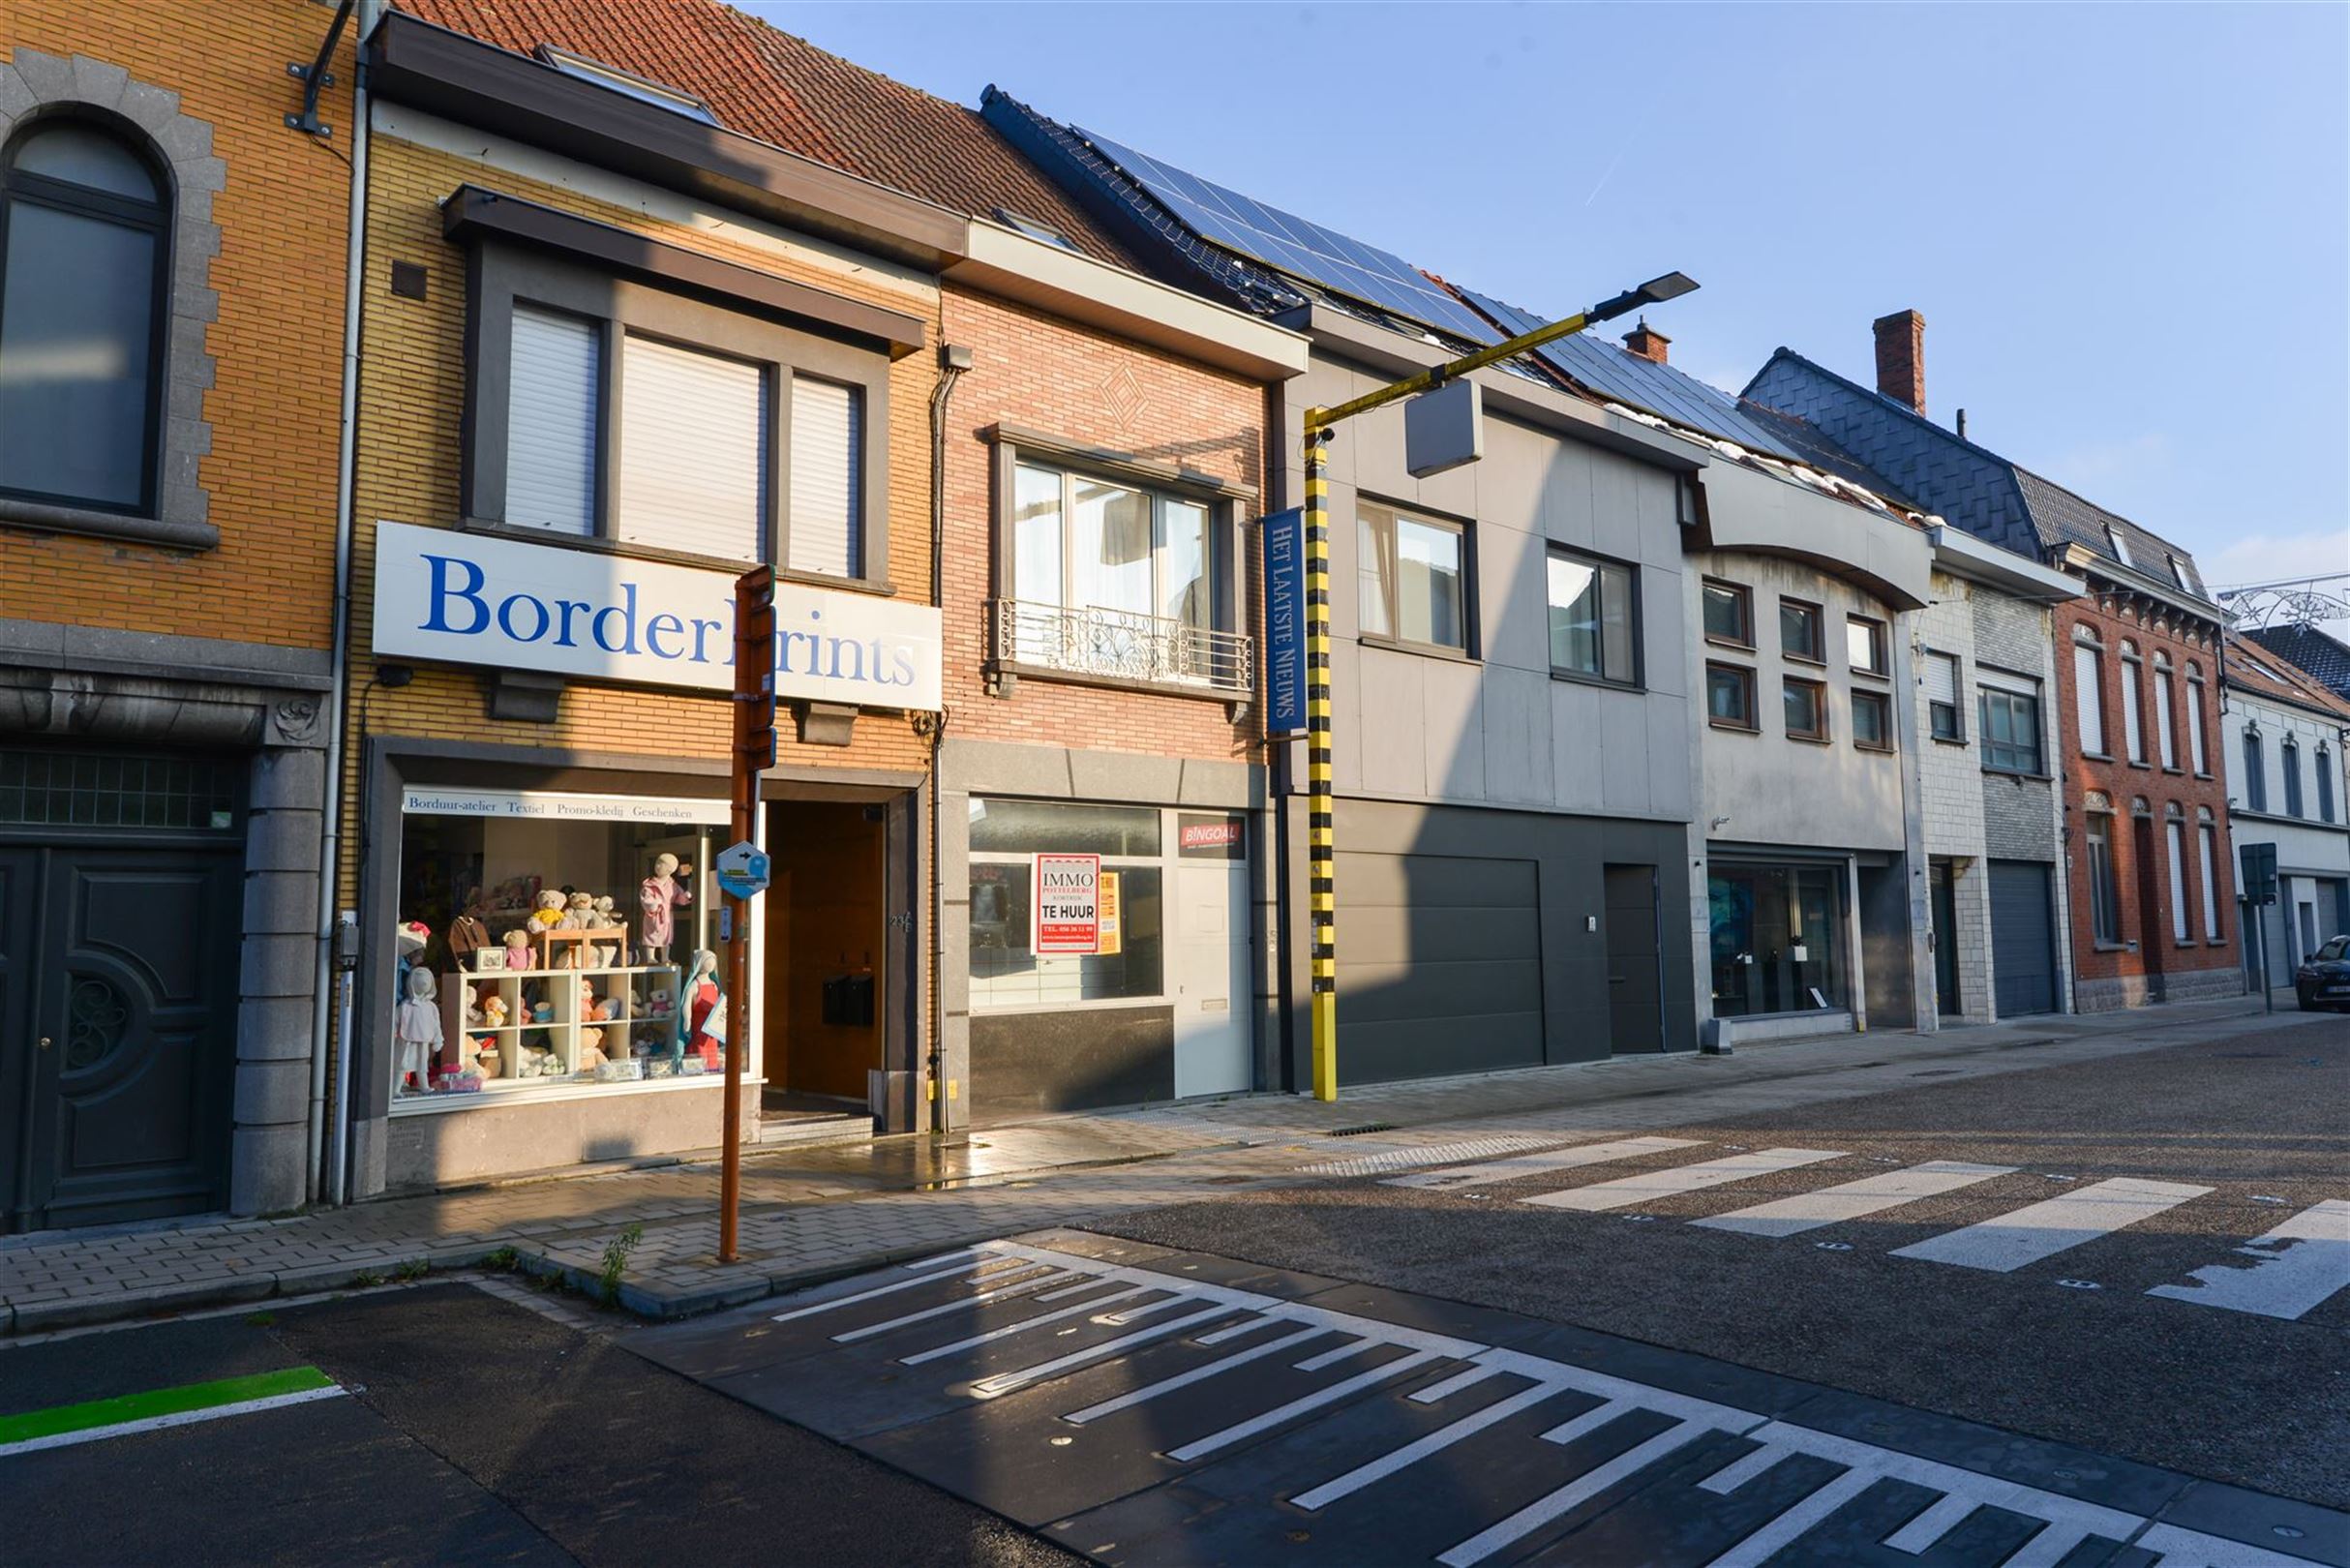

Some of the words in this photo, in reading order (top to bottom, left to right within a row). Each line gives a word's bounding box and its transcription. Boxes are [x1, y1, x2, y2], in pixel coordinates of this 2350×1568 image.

[1272, 526, 1293, 562] HET
[418, 554, 916, 687] Borderrints
[1273, 568, 1293, 645] LAATSTE
[1276, 648, 1295, 719] NIEUWS
[409, 797, 497, 812] Borduur-atelier
[507, 801, 545, 814] Textiel
[557, 803, 624, 817] Promo-kledij
[633, 805, 693, 819] Geschenken
[1043, 873, 1094, 887] IMMO
[1042, 905, 1057, 919] TE
[1060, 905, 1095, 919] HUUR
